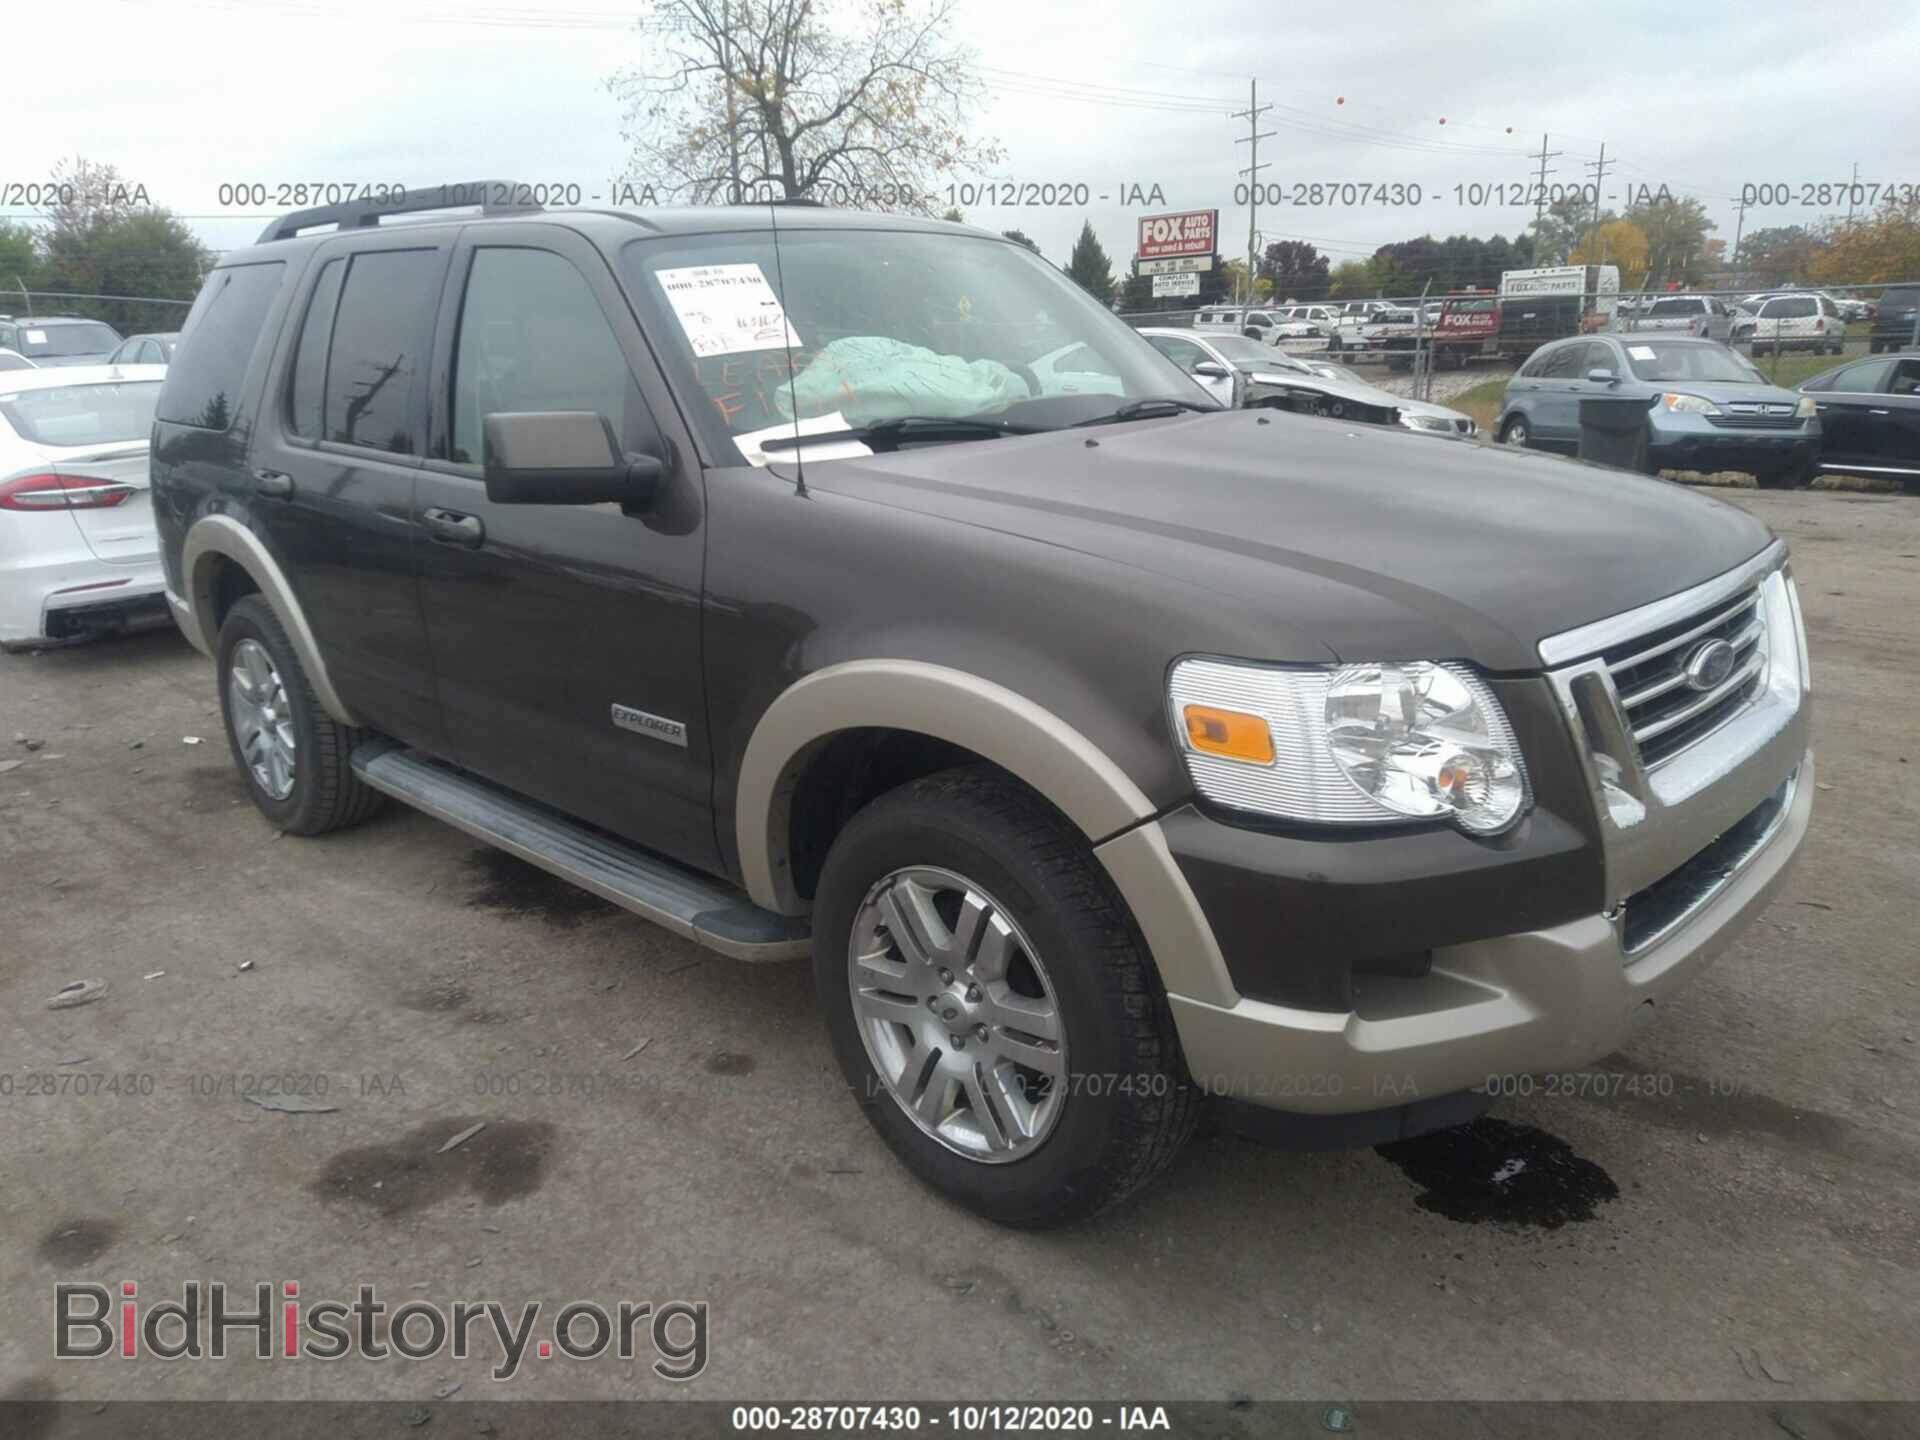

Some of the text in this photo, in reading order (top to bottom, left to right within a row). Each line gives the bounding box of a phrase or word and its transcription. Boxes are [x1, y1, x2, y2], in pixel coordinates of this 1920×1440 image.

[1184, 214, 1208, 228] AUTO
[1142, 216, 1183, 244] FOX
[1184, 226, 1211, 240] PARTS
[1511, 283, 1529, 292] FOX
[1551, 281, 1577, 290] PARTS
[1443, 313, 1472, 327] FOX
[614, 708, 681, 737] EXPLORER
